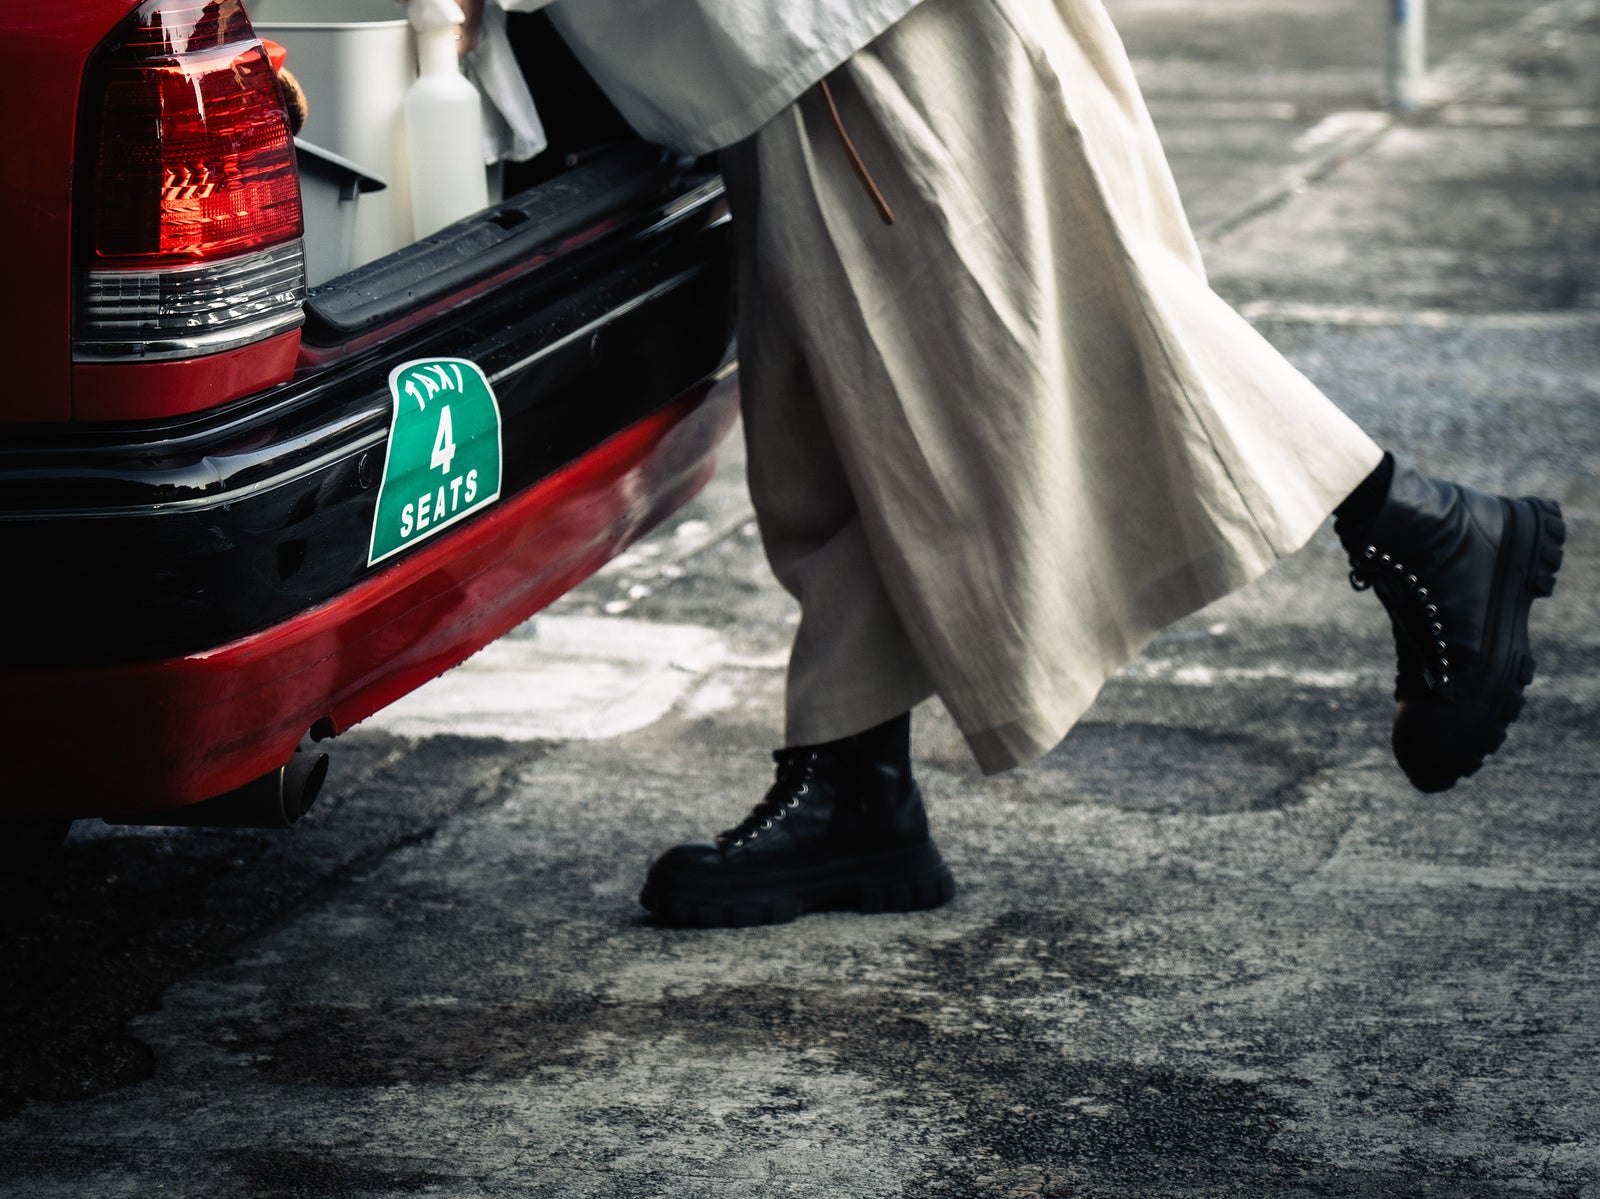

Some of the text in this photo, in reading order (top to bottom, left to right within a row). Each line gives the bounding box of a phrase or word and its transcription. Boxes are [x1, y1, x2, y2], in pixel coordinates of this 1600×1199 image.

[405, 364, 463, 411] TAXI
[429, 405, 456, 475] 4
[400, 469, 478, 538] SEATS
